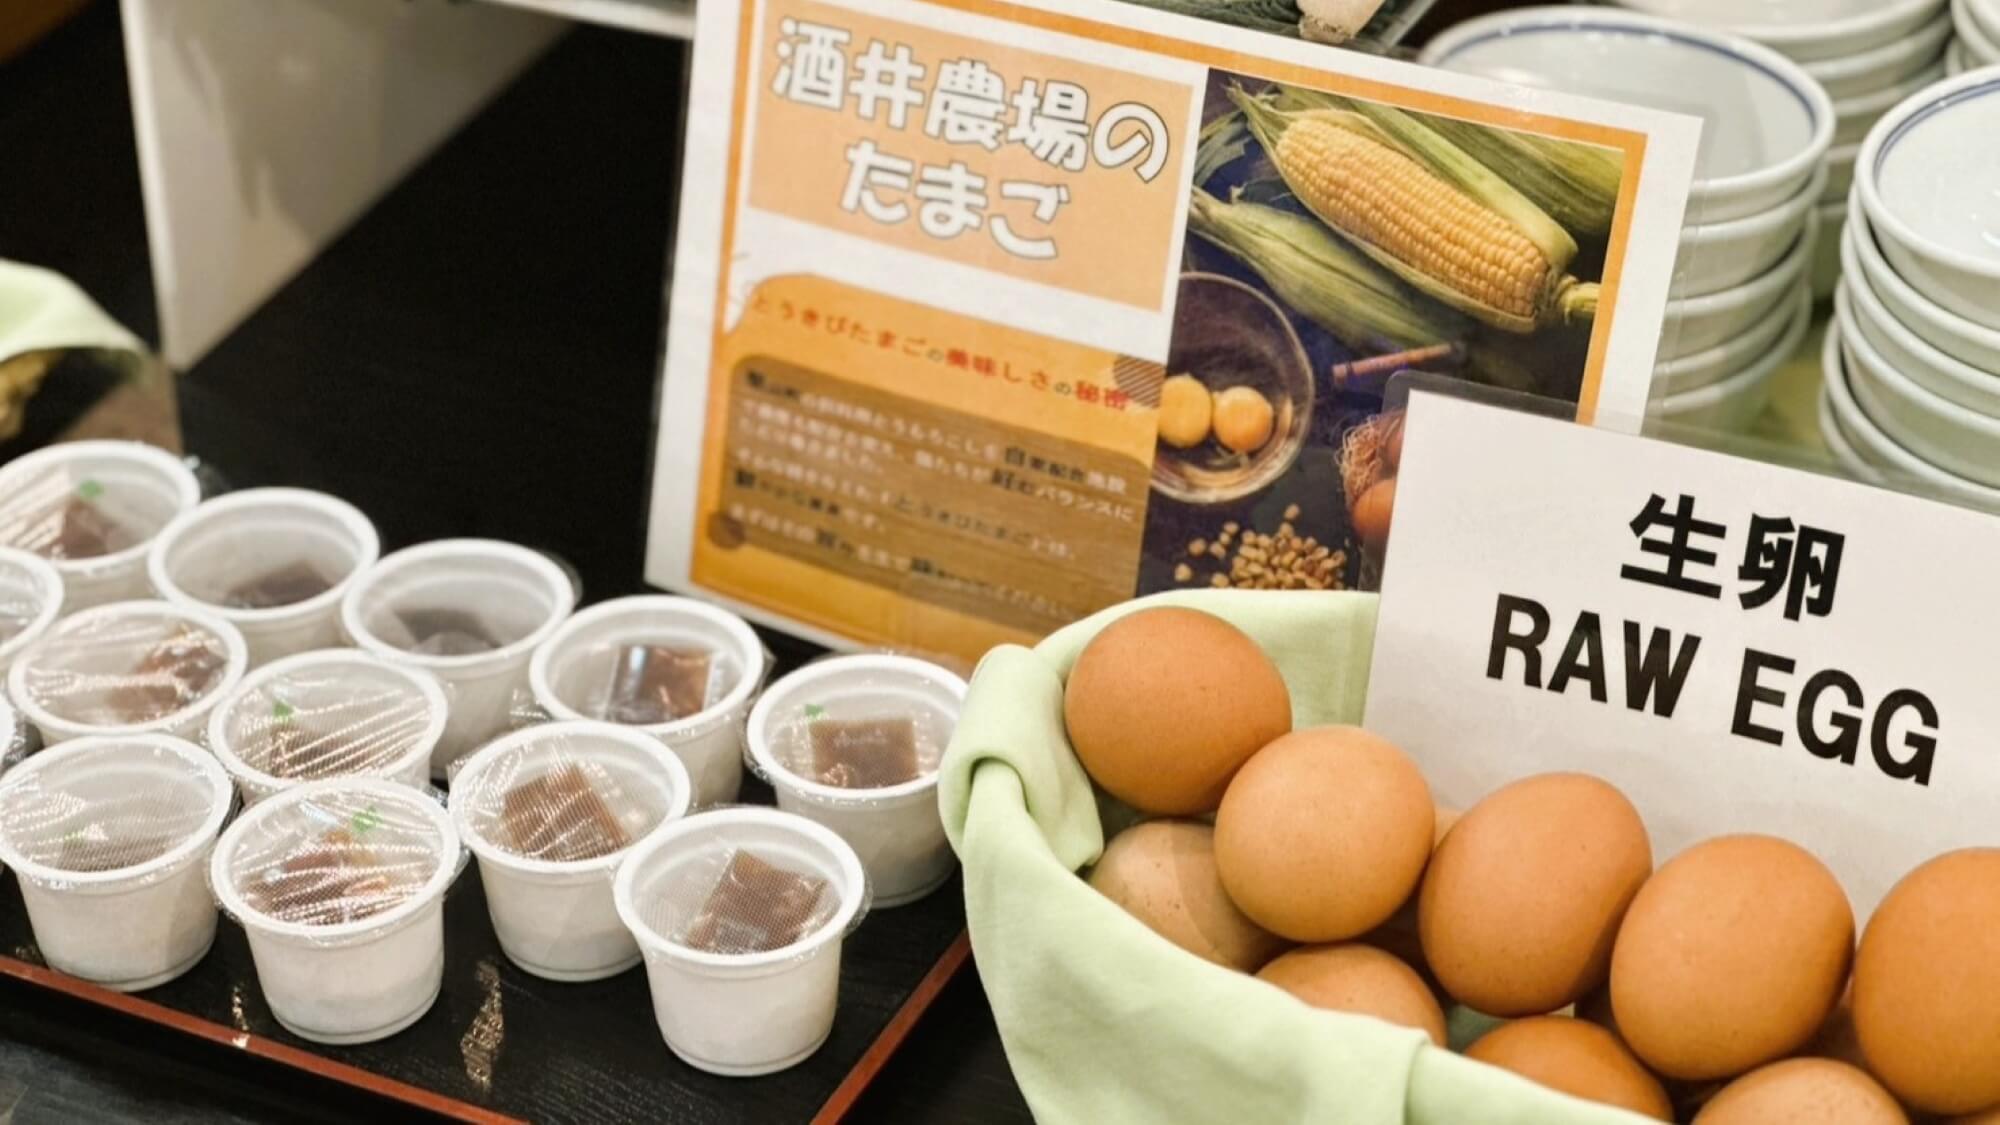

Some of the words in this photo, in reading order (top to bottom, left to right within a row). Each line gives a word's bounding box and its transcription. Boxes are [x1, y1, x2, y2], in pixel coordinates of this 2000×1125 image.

[770, 16, 1170, 184] 酒井農場の
[839, 137, 1070, 260] たまご
[1620, 493, 1845, 622] 生卵
[1486, 593, 1702, 718] RAW
[1731, 647, 1939, 786] EGG
